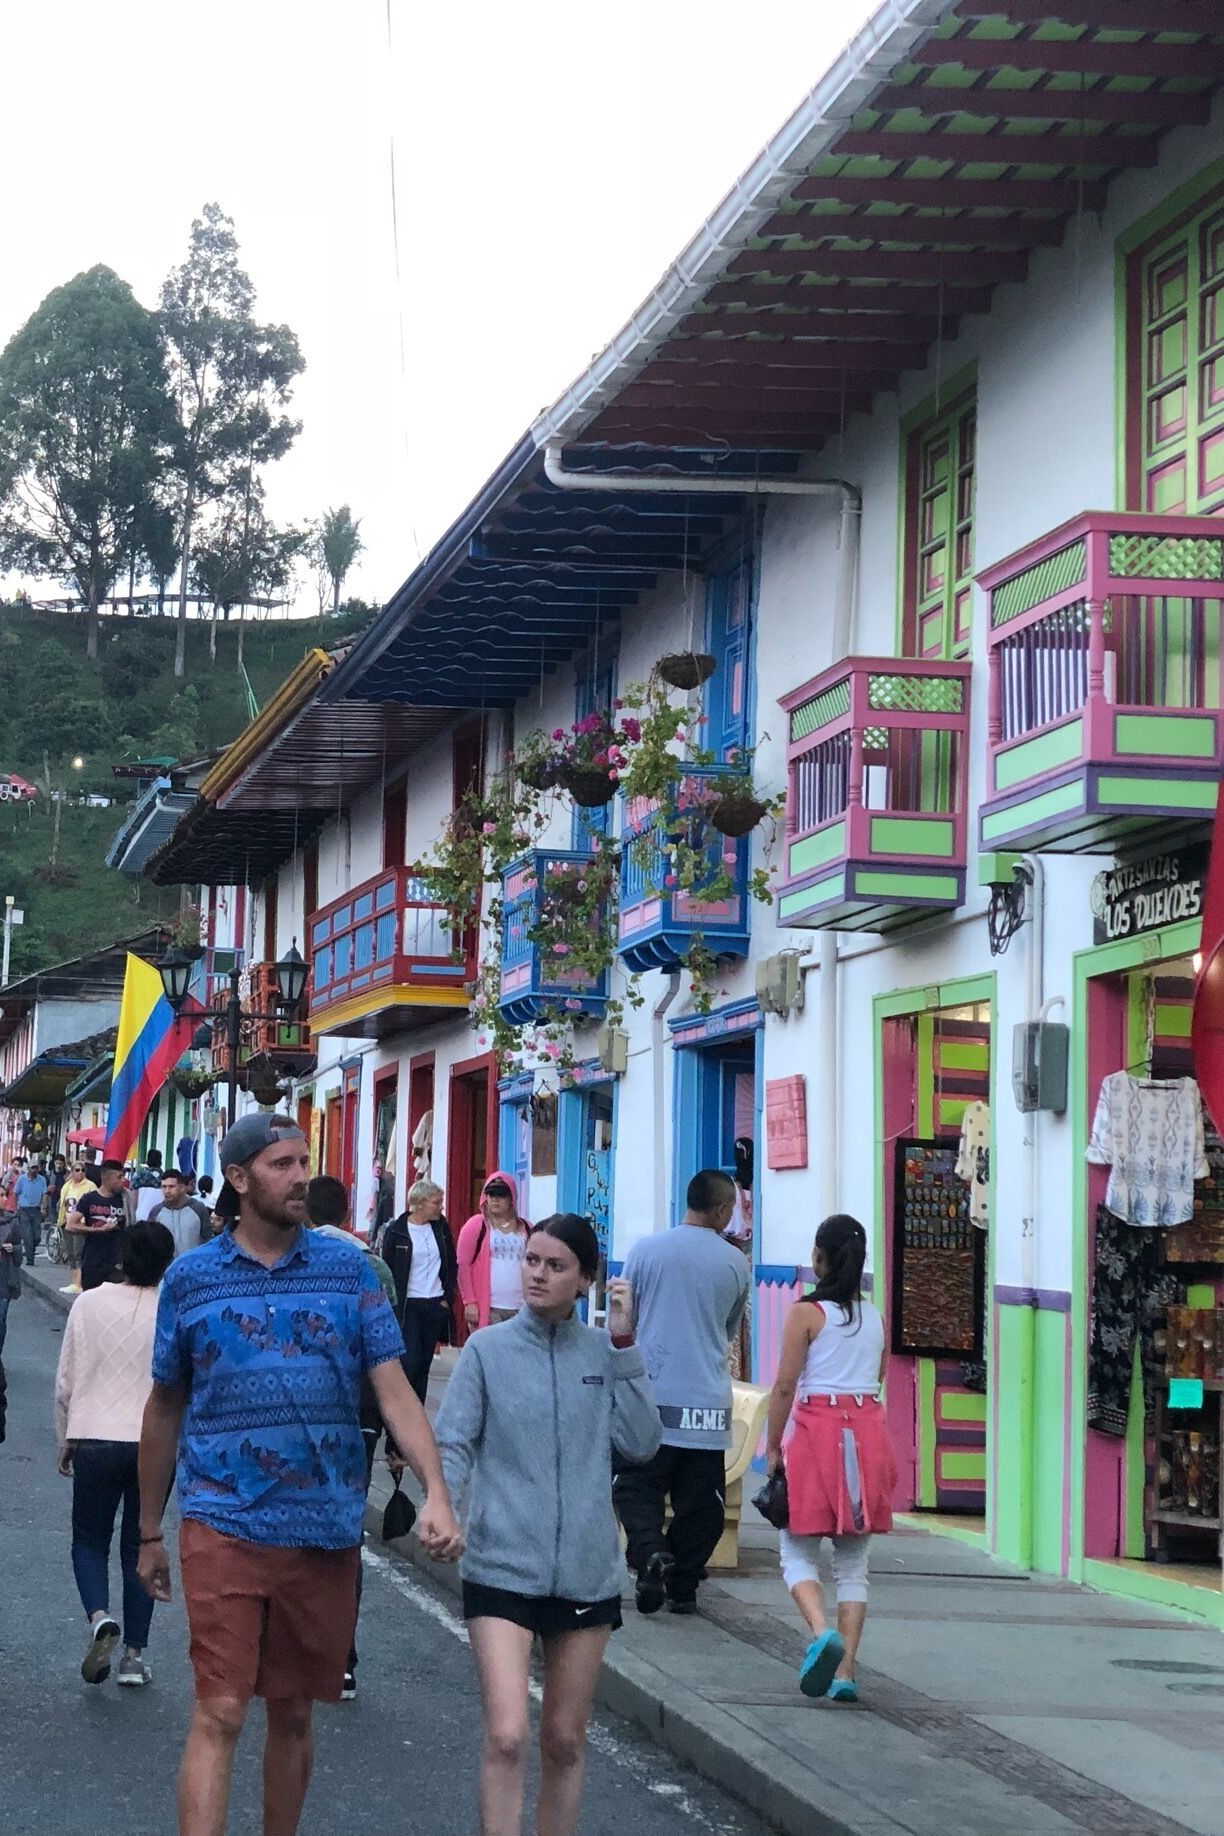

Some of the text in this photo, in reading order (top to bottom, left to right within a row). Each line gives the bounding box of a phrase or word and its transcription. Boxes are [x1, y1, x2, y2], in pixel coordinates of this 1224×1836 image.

[1104, 880, 1201, 938] LOS DUENDES
[680, 1407, 726, 1431] ACME
